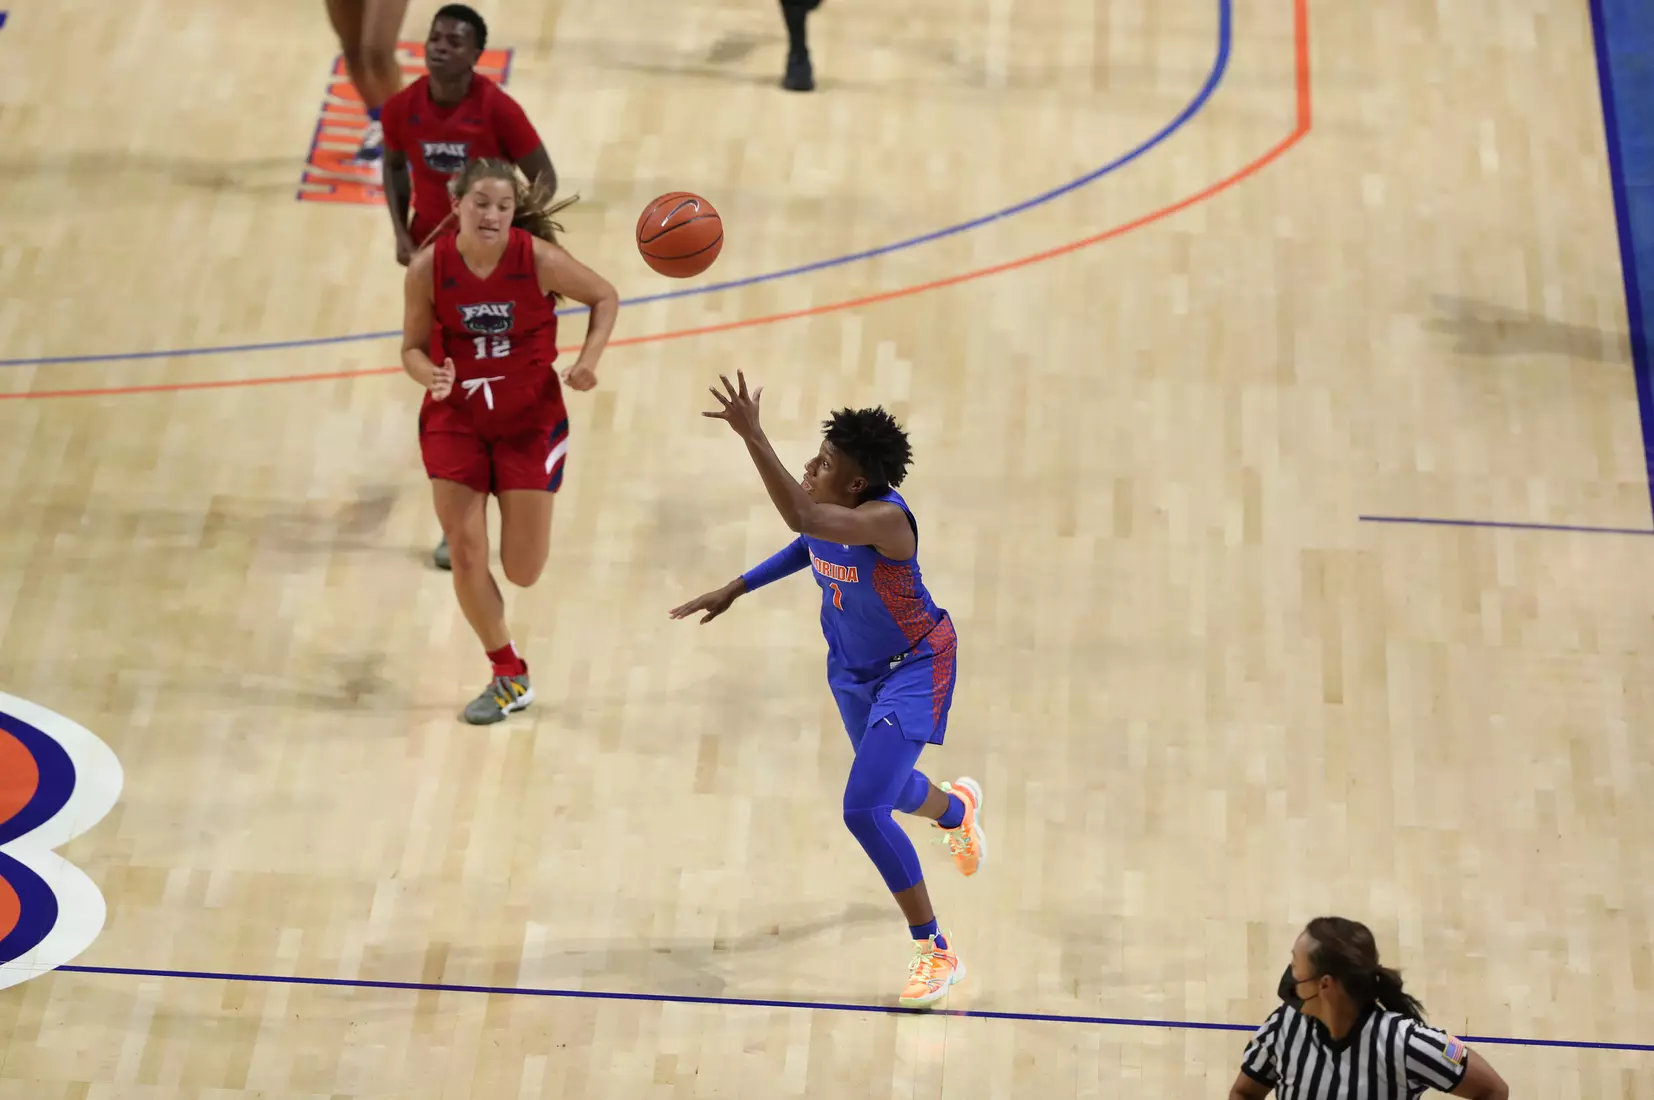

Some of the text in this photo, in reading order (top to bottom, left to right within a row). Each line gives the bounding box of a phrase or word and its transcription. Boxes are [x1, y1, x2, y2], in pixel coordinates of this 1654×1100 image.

[462, 303, 510, 320] FAU
[473, 335, 511, 360] 12
[809, 548, 859, 583] ORIDA
[829, 582, 844, 611] 1
